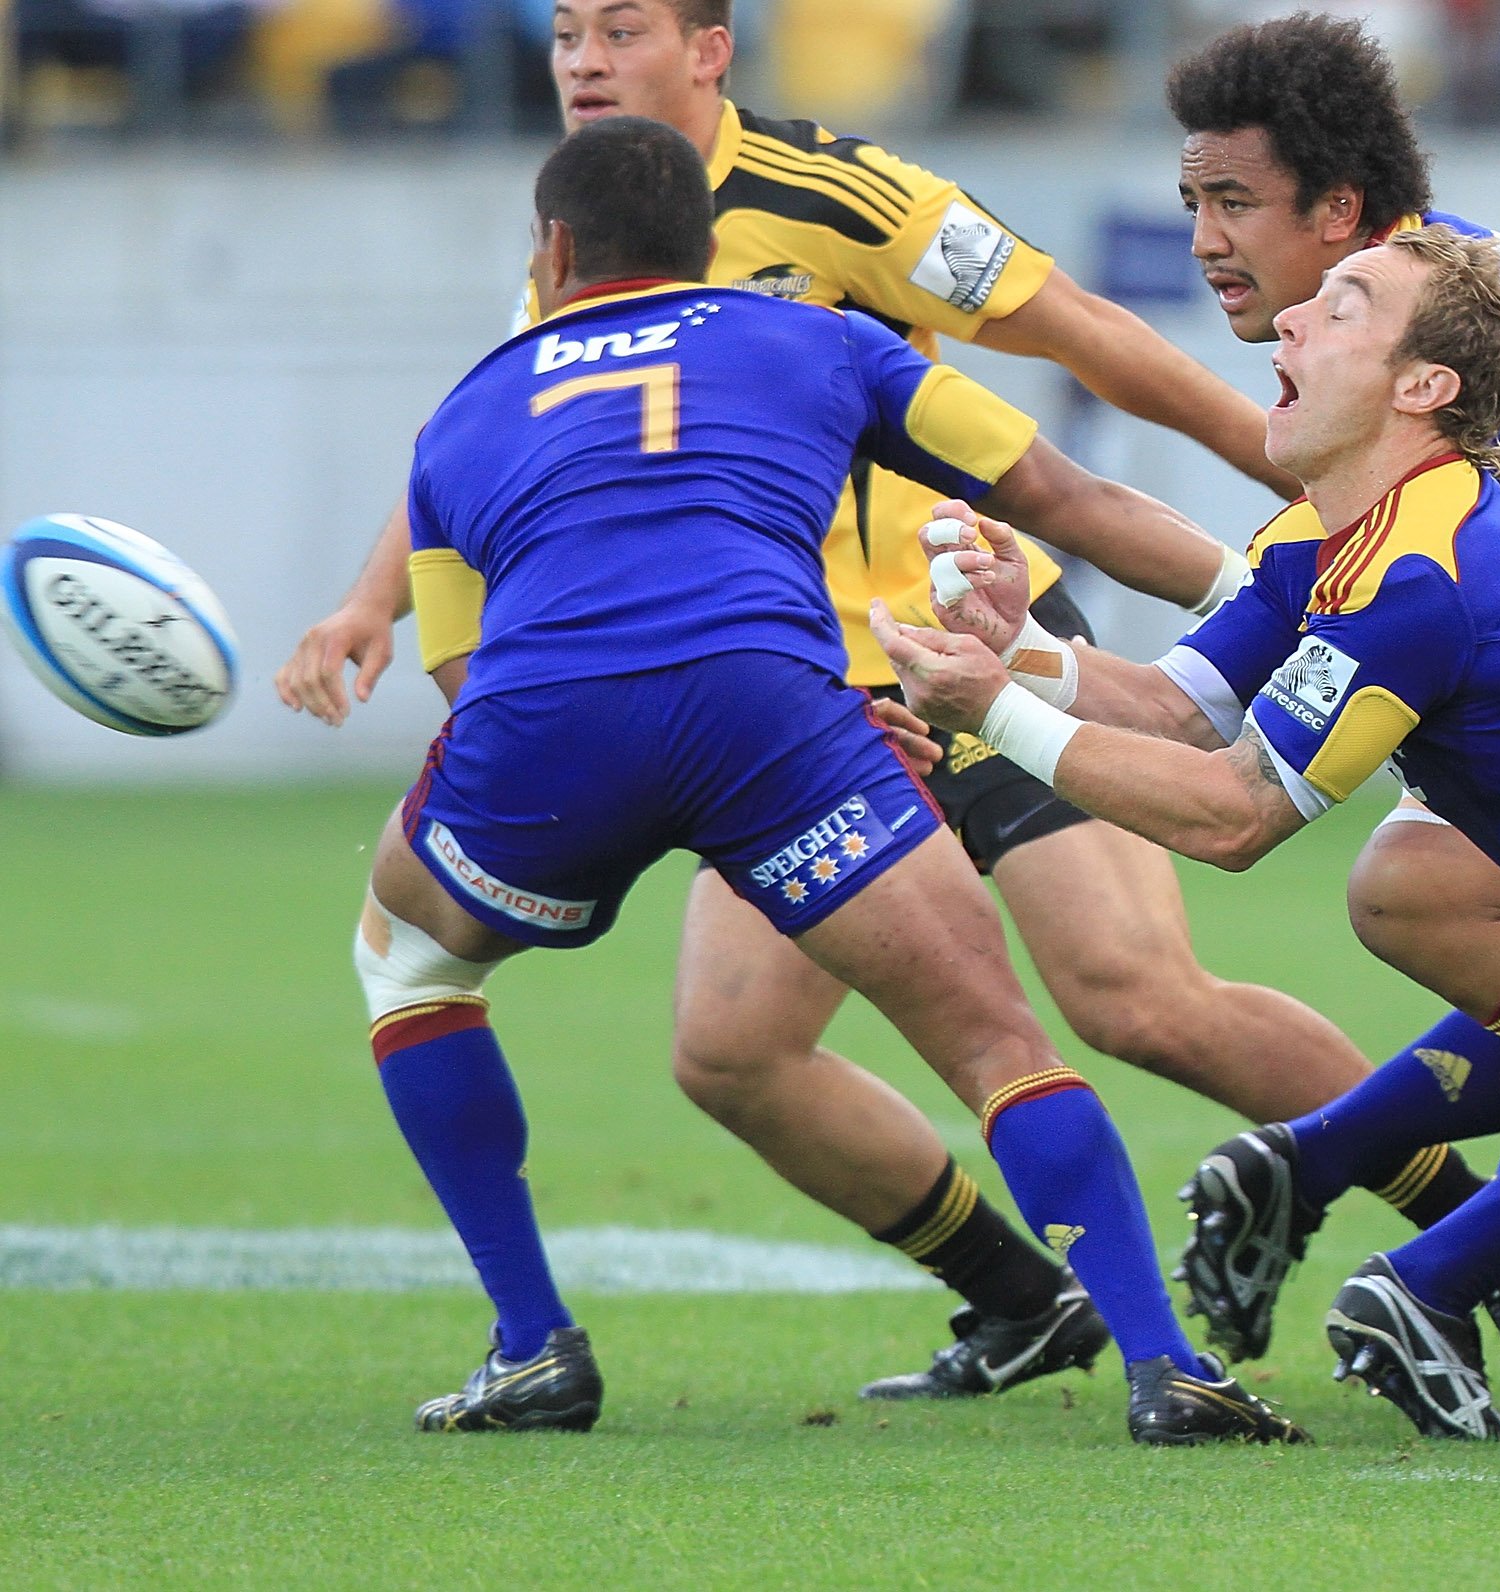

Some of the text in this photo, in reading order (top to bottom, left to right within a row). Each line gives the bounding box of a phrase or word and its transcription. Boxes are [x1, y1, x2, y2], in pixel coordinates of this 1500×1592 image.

[968, 235, 1016, 306] Investec
[534, 322, 681, 375] bnz
[529, 363, 680, 454] 7
[47, 573, 222, 714] GILBERT
[433, 824, 584, 921] LOCATIONS
[751, 796, 866, 888] SPEIGHT'S
